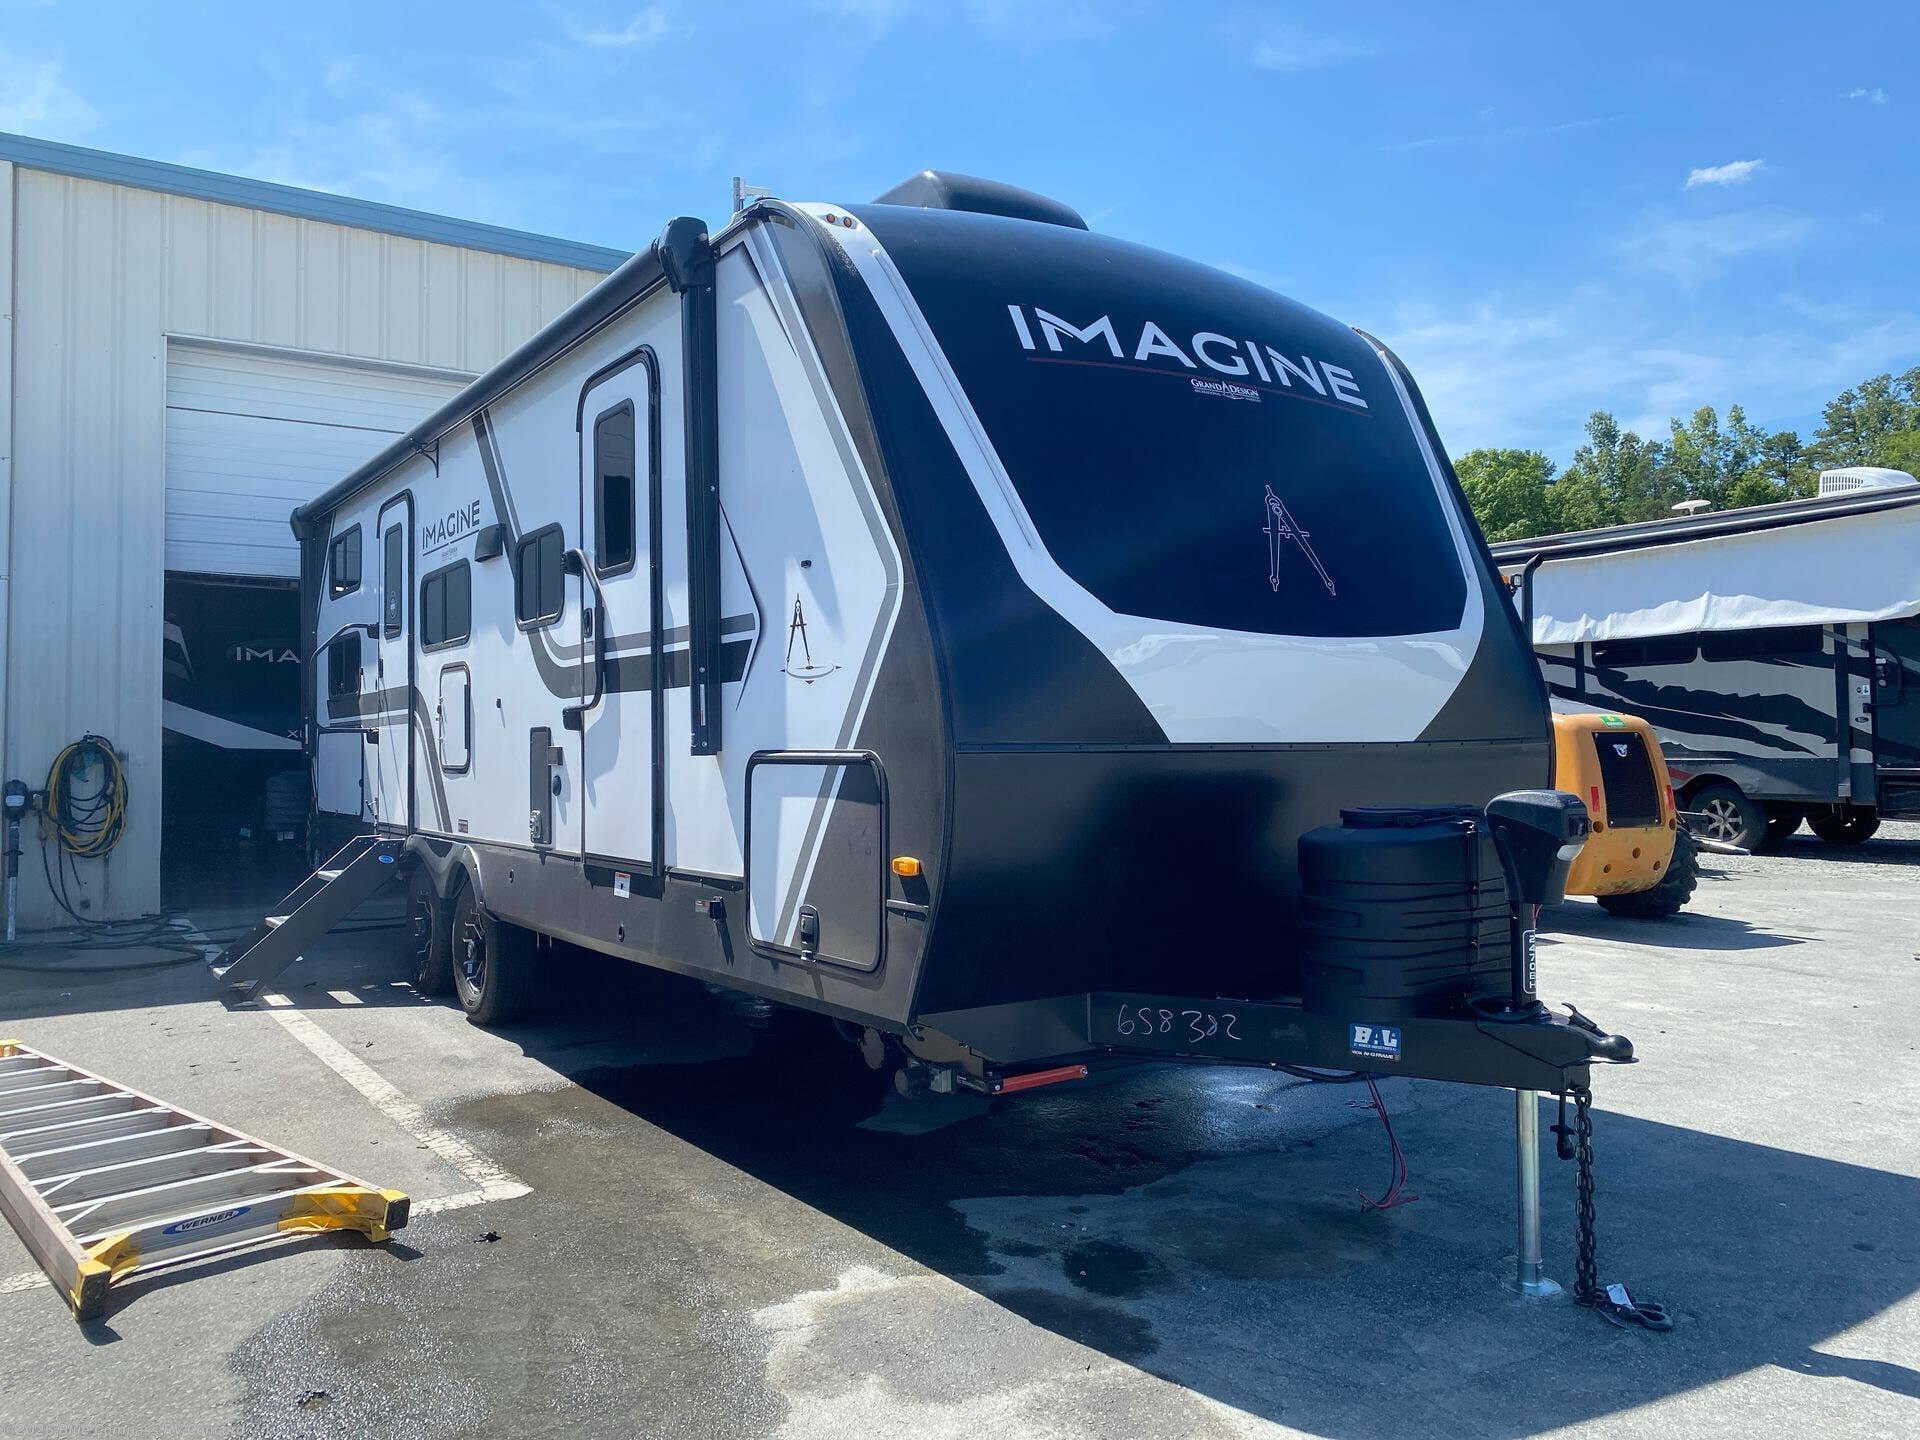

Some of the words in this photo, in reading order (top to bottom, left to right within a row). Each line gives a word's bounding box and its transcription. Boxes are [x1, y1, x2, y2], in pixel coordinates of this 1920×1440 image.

[1007, 304, 1368, 409] IMAGINE
[1190, 377, 1222, 391] GRAND
[422, 499, 480, 550] IMAGINE
[1353, 1026, 1398, 1047] BAL
[180, 1210, 235, 1231] WERNER
